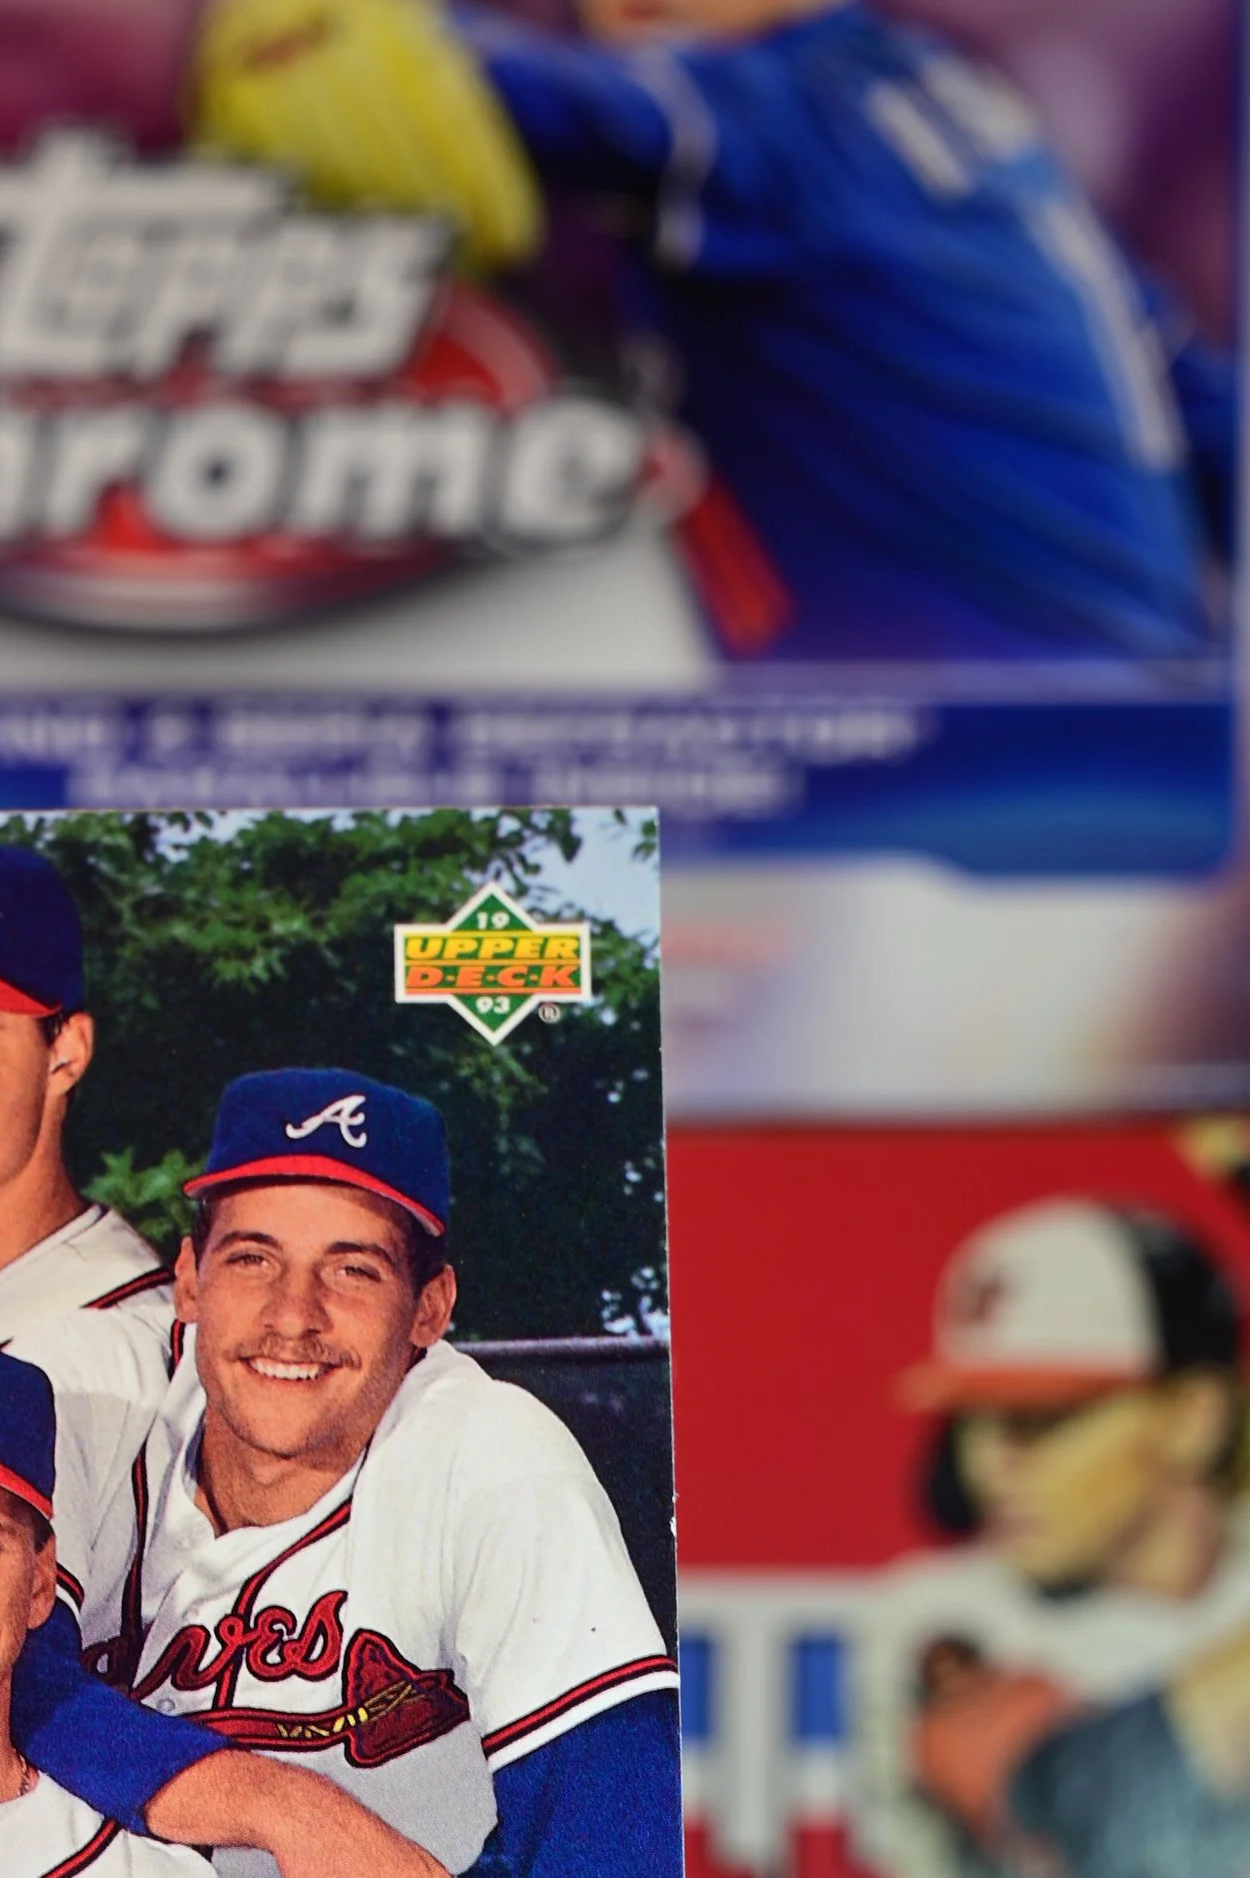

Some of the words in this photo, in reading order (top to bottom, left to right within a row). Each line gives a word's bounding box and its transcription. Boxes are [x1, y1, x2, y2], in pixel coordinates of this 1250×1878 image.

[476, 911, 510, 931] 19
[406, 936, 579, 960] UPPER
[476, 995, 510, 1014] 93
[285, 1095, 367, 1148] A
